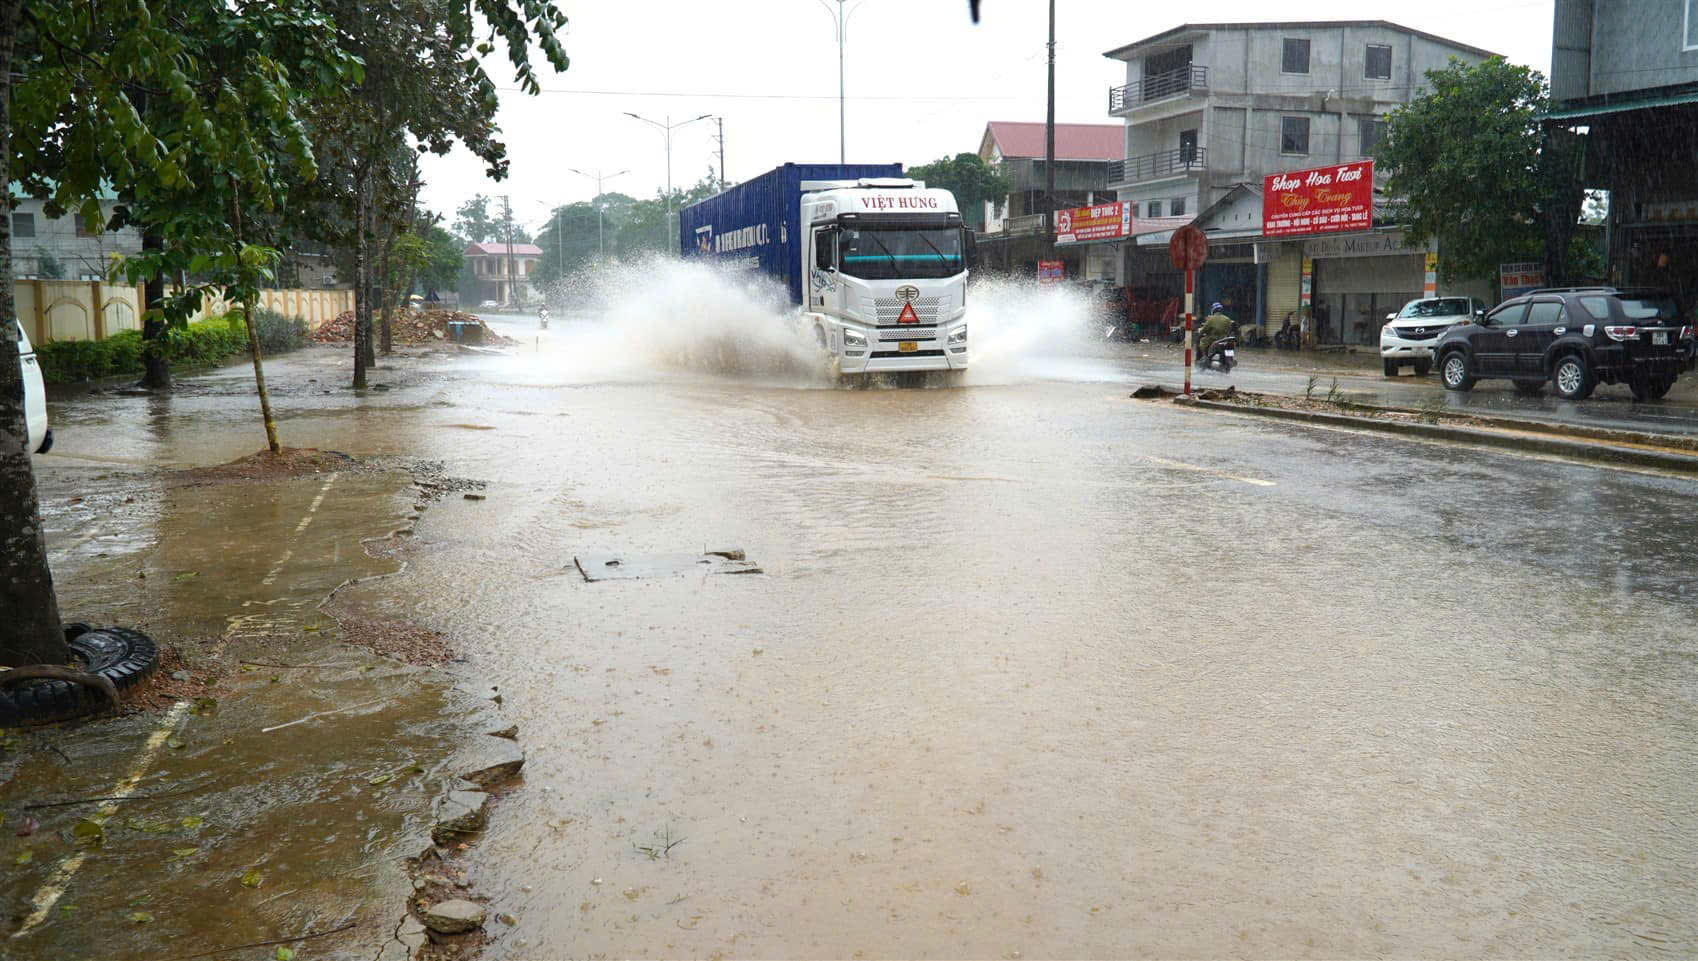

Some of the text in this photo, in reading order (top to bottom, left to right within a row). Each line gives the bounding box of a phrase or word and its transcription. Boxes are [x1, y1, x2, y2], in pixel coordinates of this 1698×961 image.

[1272, 167, 1363, 192] Shop Hoa Tươi
[861, 194, 938, 211] VIỆT HƯNG
[1315, 188, 1353, 207] Trang
